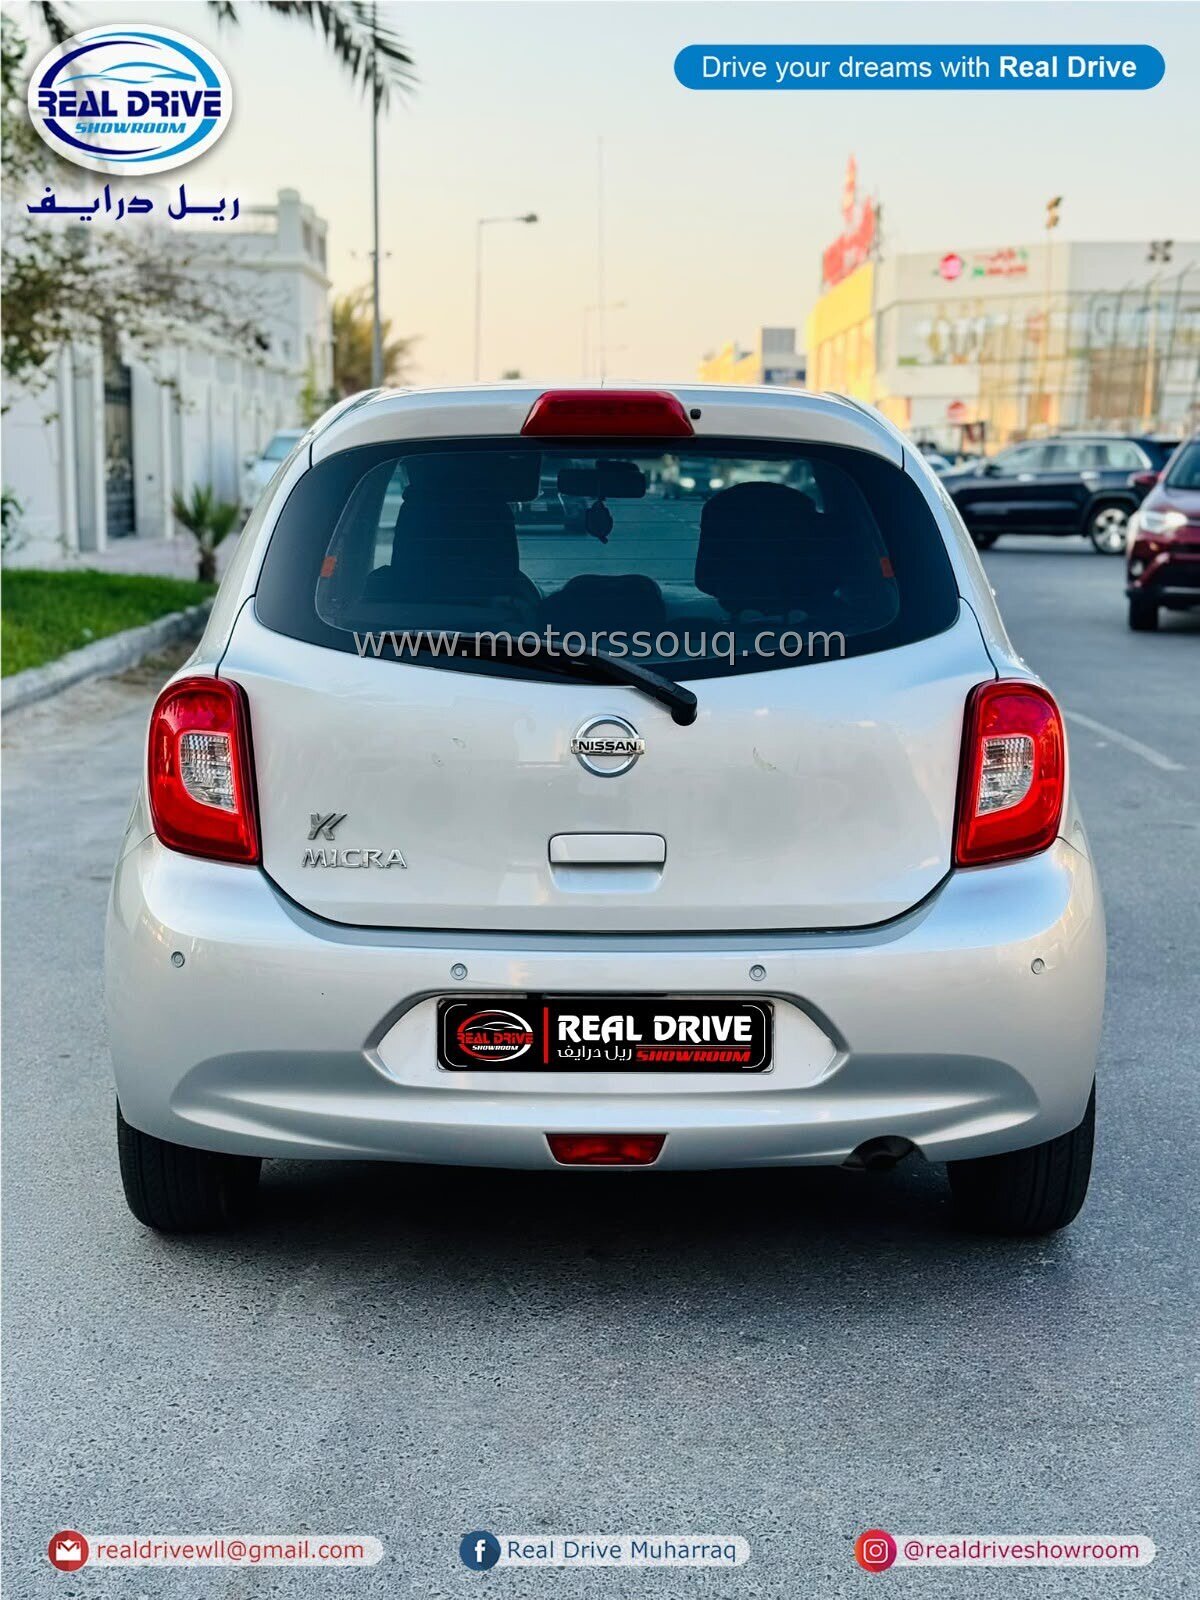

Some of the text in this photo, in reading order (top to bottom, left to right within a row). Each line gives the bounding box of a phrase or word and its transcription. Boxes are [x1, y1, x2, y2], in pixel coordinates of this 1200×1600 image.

[578, 741, 637, 751] NISSAN
[301, 848, 408, 869] MICRA
[557, 1015, 753, 1044] REAL DRIVE
[457, 1032, 490, 1044] REAL
[635, 1050, 752, 1063] SHOWROOM
